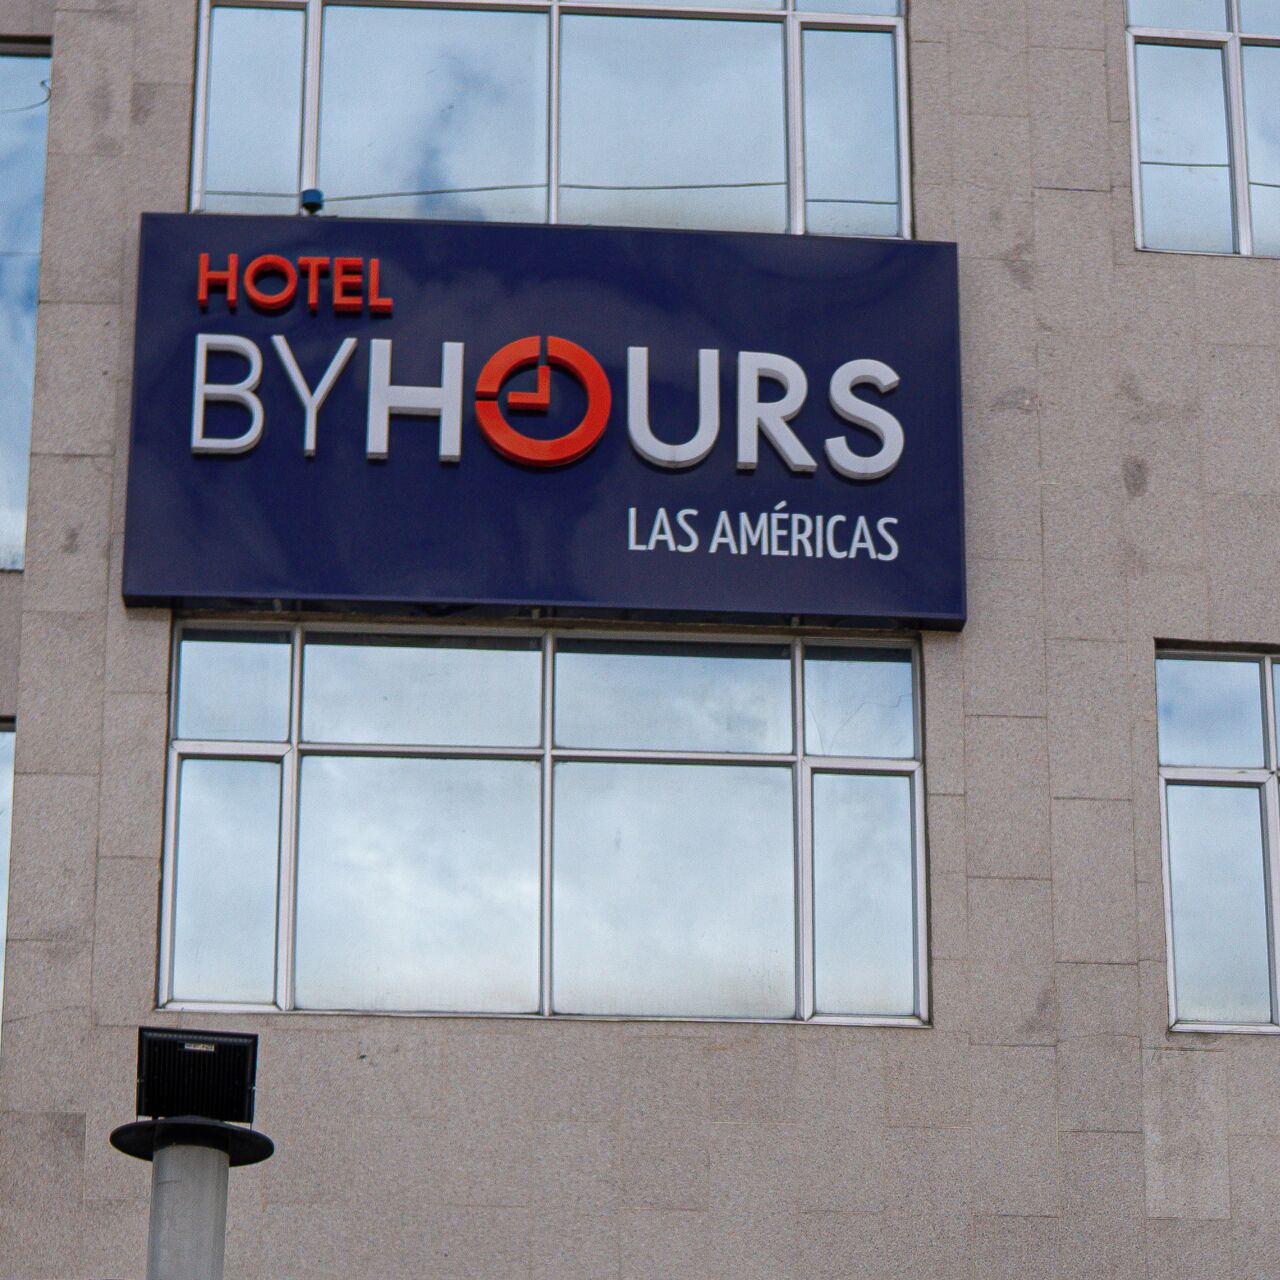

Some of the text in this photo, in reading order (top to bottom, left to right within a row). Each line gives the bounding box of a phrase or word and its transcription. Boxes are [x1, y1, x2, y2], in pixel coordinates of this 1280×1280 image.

[197, 253, 393, 313] HOTEL
[191, 333, 904, 480] BYHOURS
[628, 500, 900, 562] LAS AMÉRICAS
